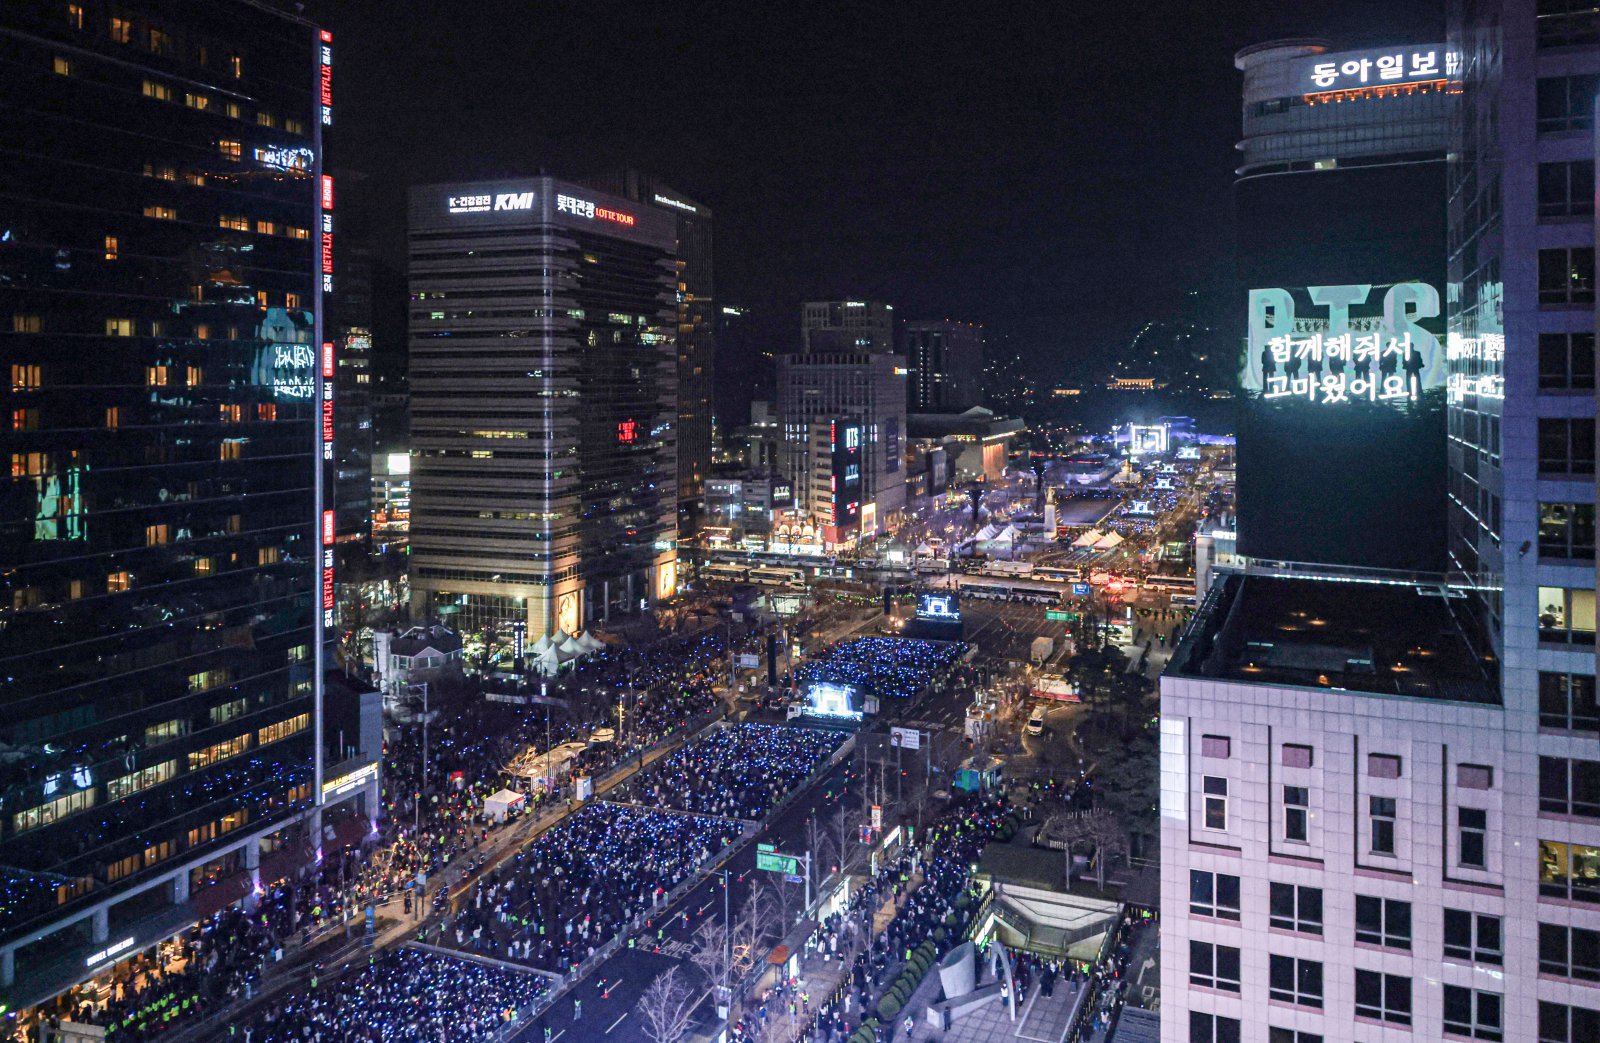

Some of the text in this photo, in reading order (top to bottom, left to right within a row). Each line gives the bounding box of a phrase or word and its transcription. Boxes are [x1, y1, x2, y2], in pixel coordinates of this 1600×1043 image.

[1310, 51, 1439, 87] 동아일보
[494, 192, 534, 211] KMI
[557, 194, 634, 225] 롯데관광 LOTTE TOUR
[1268, 332, 1411, 363] 함께해줘서
[1264, 372, 1418, 404] 고마웠어요!
